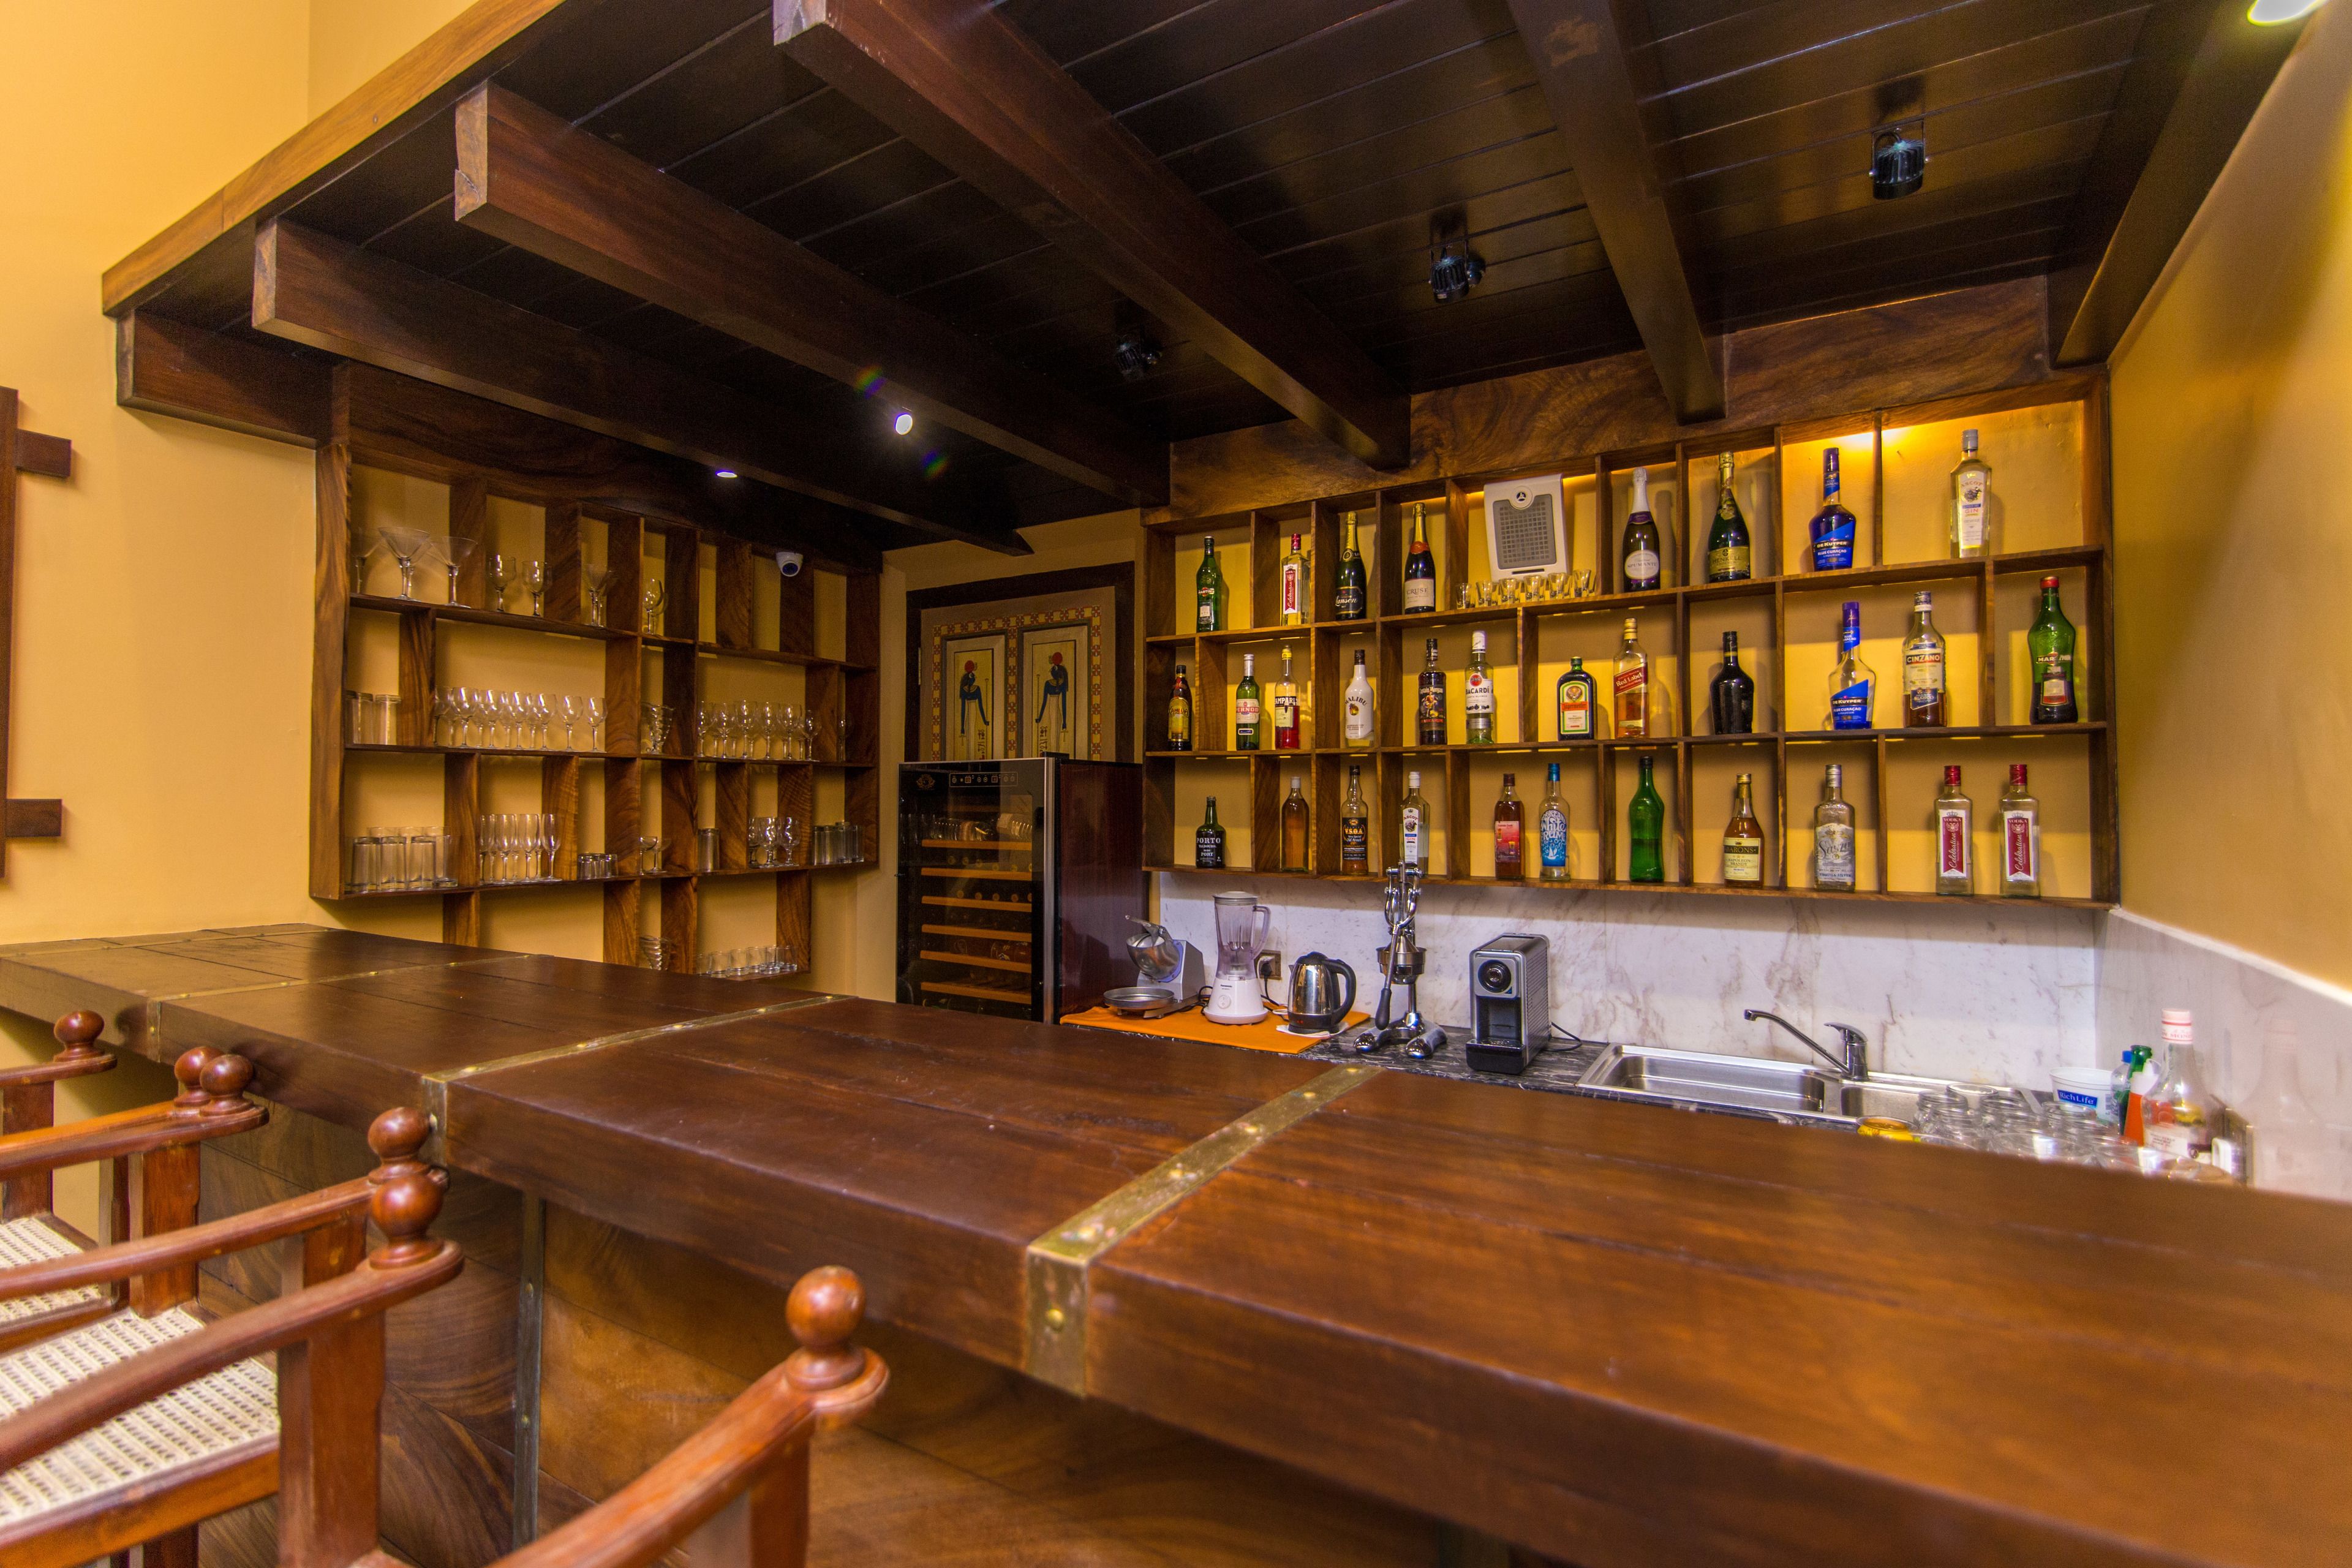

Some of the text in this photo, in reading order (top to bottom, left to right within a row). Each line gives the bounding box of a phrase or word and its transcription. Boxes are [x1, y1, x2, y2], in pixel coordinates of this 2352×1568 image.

[1335, 595, 1357, 606] Lanson
[1627, 673, 1642, 682] Label
[1466, 686, 1490, 695] BACARDÍ
[1344, 696, 1368, 706] MALIBU
[1541, 816, 1566, 832] White
[1543, 831, 1566, 842] RUM
[1948, 832, 1957, 868] Celebration
[2014, 834, 2024, 871] Celebration
